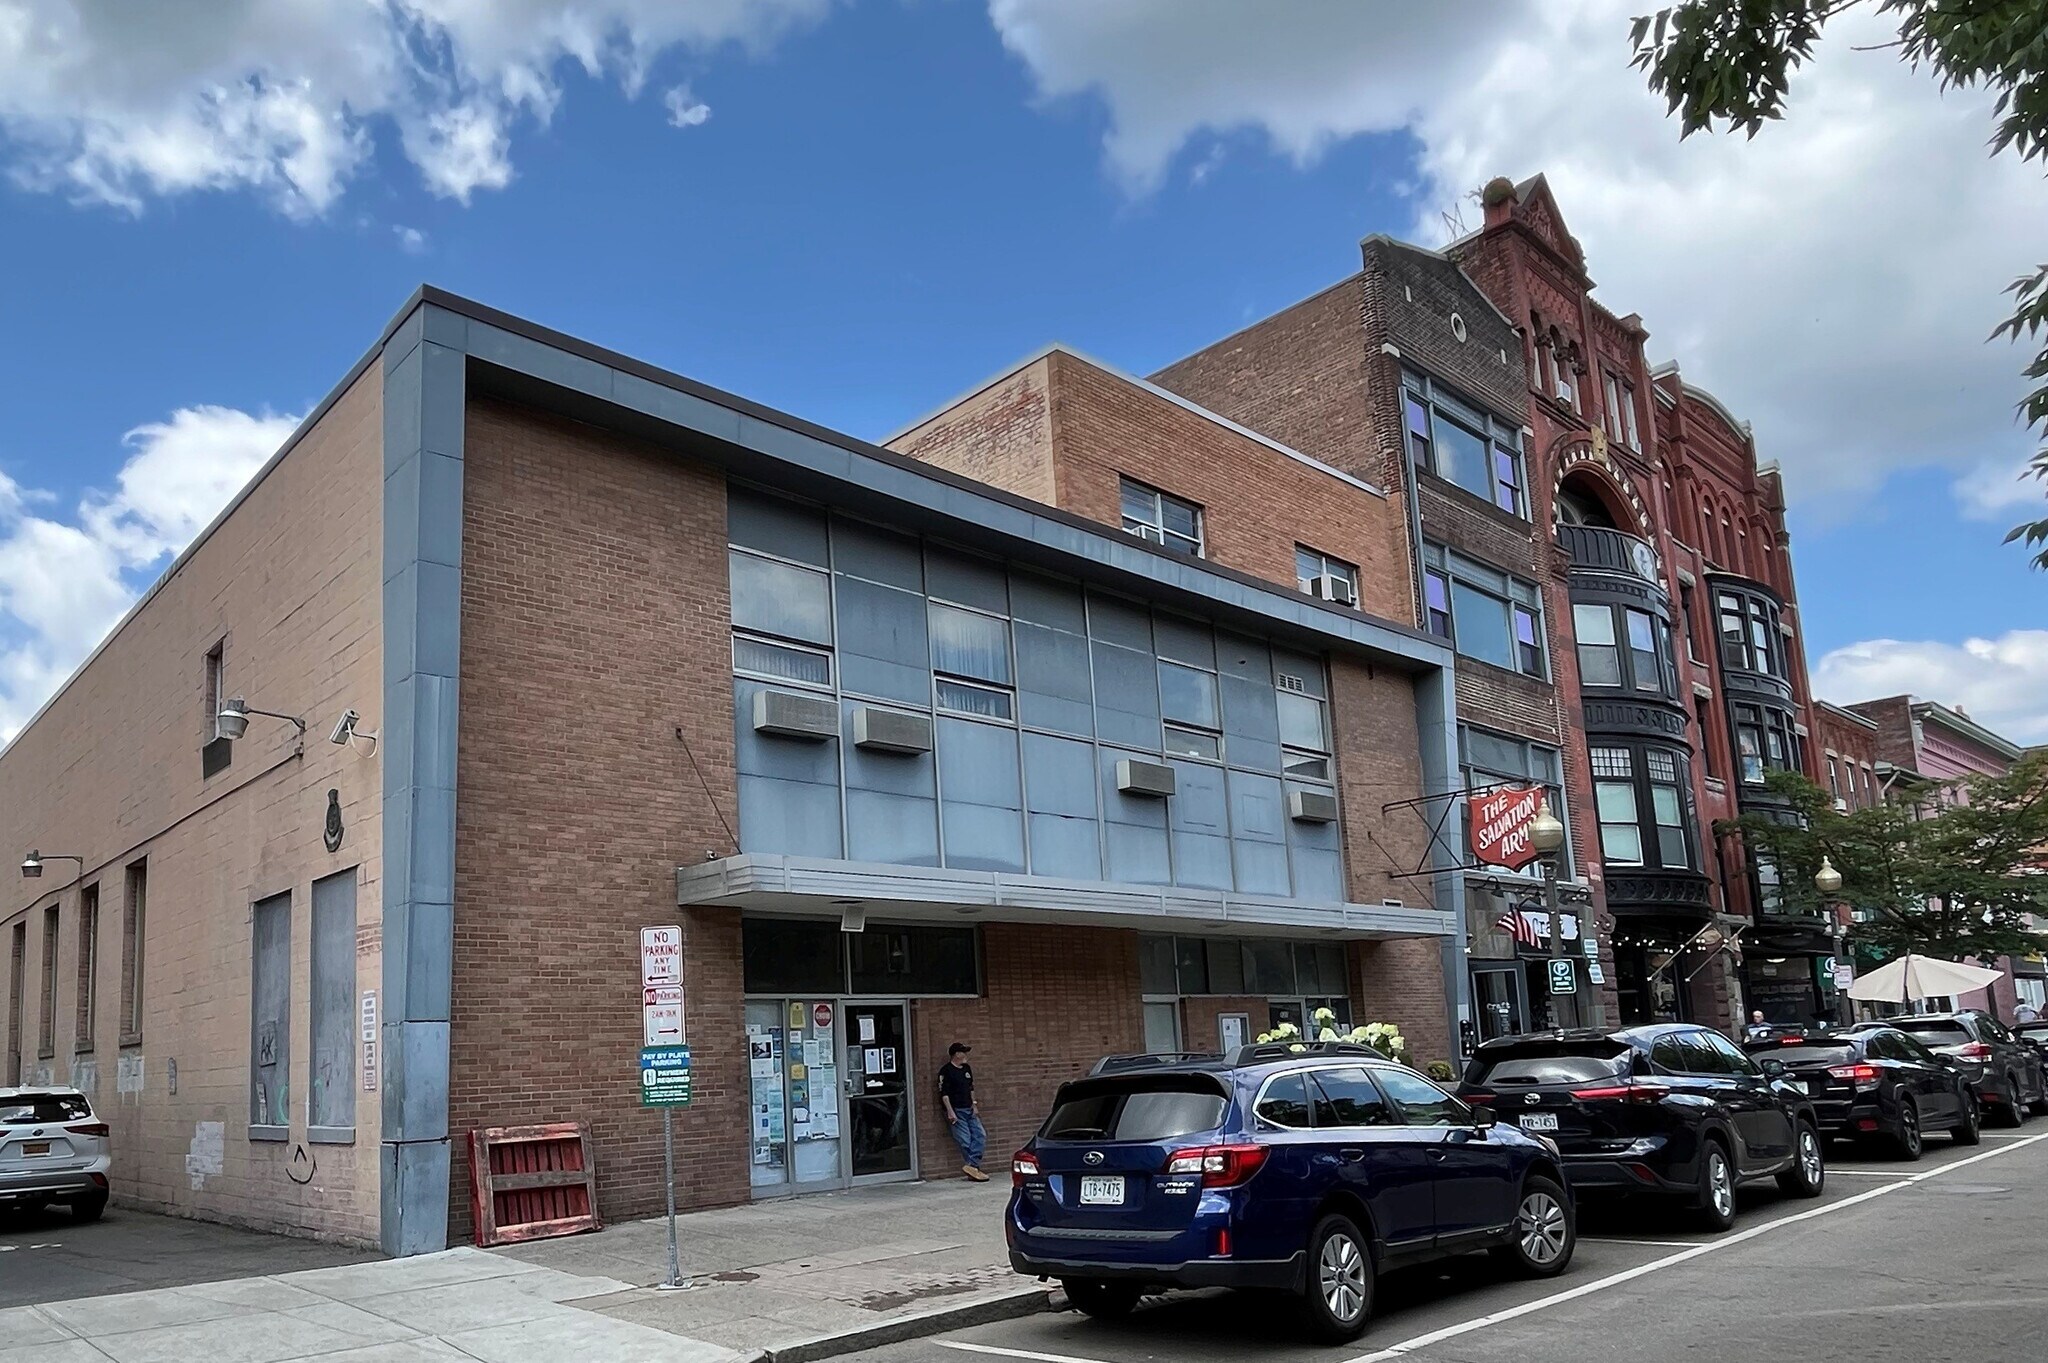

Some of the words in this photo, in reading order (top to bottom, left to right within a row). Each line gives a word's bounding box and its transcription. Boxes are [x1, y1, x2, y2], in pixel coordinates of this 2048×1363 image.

[1481, 794, 1508, 823] THE
[1478, 792, 1535, 850] SALVATION
[654, 932, 669, 943] NO
[645, 944, 679, 956] PARKING
[654, 957, 670, 965] ANY
[653, 965, 671, 974] TIME
[645, 990, 656, 1004] NO
[656, 991, 680, 1001] PARKING
[668, 1051, 690, 1059] PLATE
[651, 1058, 682, 1067] PARKING
[657, 1069, 689, 1077] PAYMENT
[656, 1076, 690, 1084] REQUIRED
